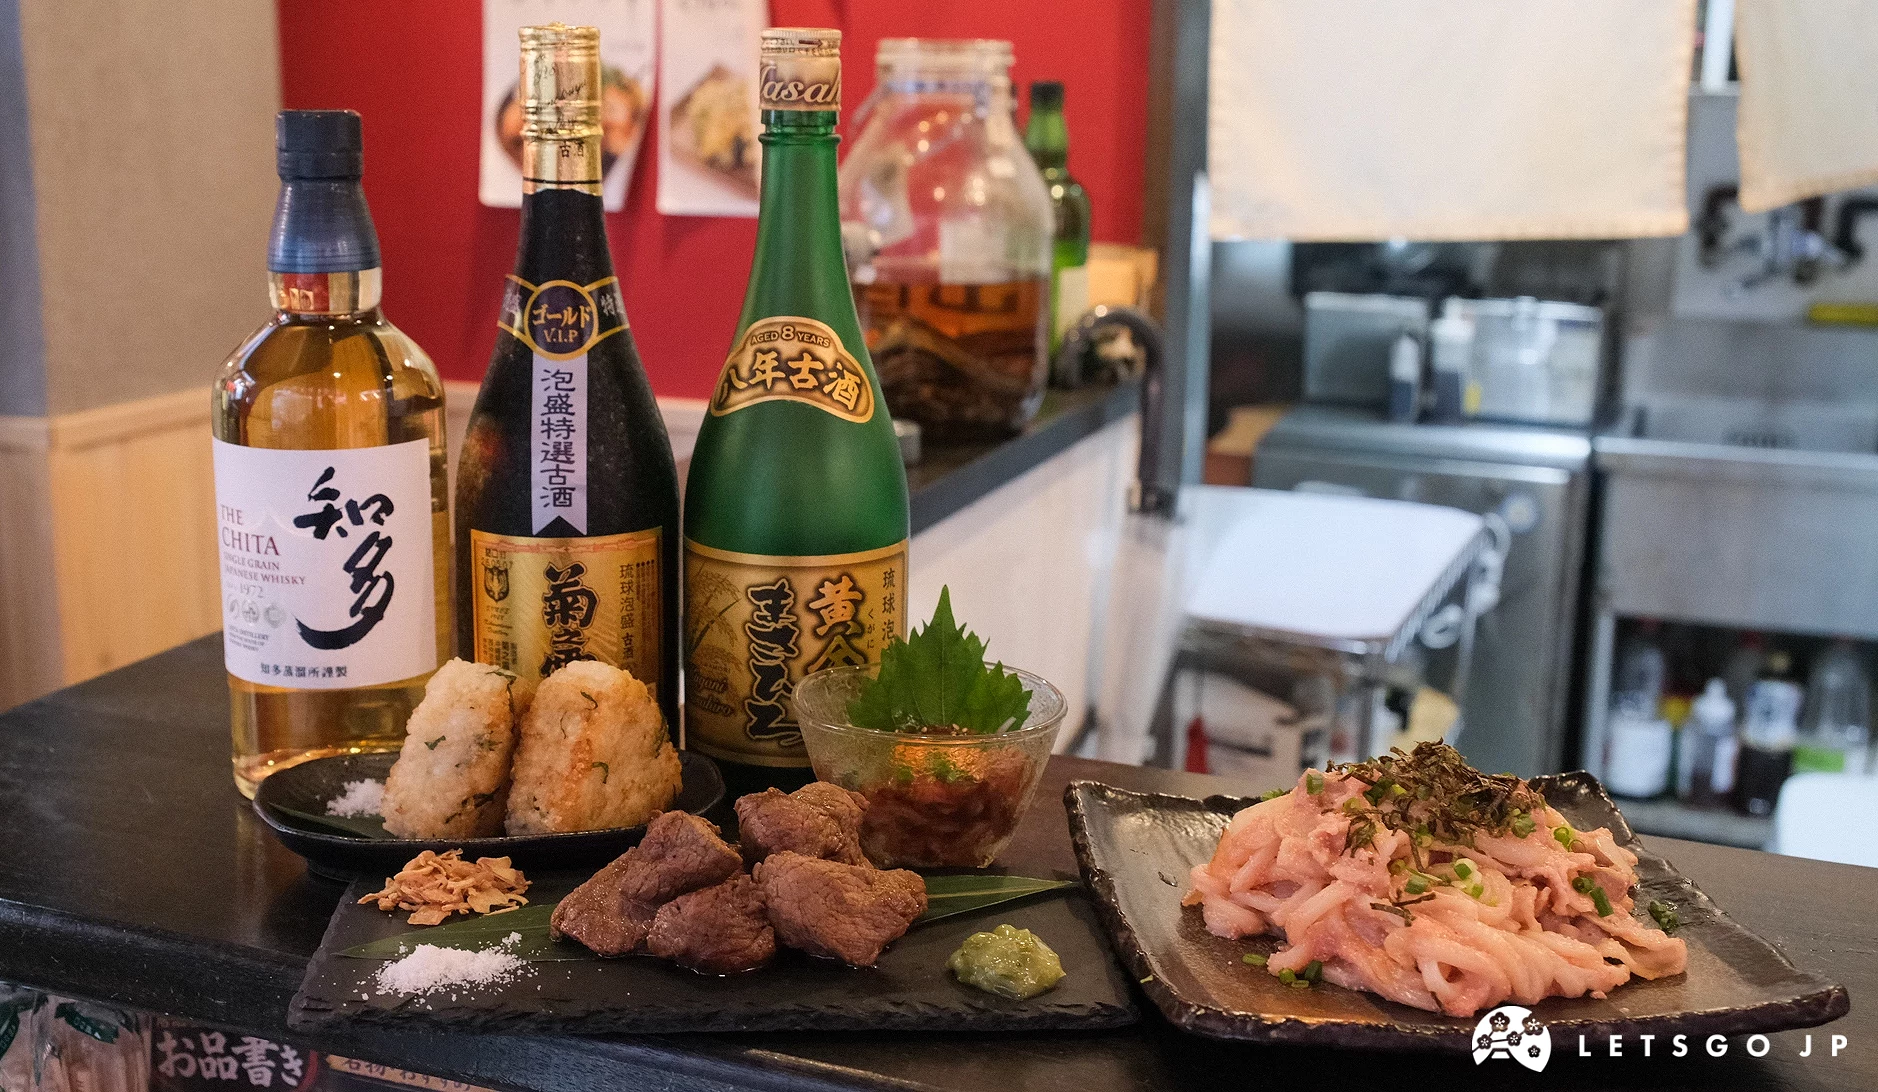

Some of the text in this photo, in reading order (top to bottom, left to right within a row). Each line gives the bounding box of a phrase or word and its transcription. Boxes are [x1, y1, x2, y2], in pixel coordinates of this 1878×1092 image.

[559, 140, 585, 158] 古酒
[532, 303, 592, 329] ゴールド
[543, 327, 579, 344] V.I.P
[751, 325, 831, 348] AGED 8 YEARS
[719, 350, 862, 411] 八年古酒
[540, 368, 576, 509] 泡盛特選古酒
[220, 503, 243, 526] THE
[221, 526, 281, 557] CHITA
[247, 557, 281, 571] GRAIN
[291, 465, 395, 651] 知多
[224, 563, 307, 586] JAPANESE WHISKY
[239, 582, 265, 599] 1972
[881, 567, 897, 649] 琉球泡
[866, 608, 877, 649] くがに
[745, 577, 806, 746] まさひろ
[156, 1029, 304, 1088] お品書き
